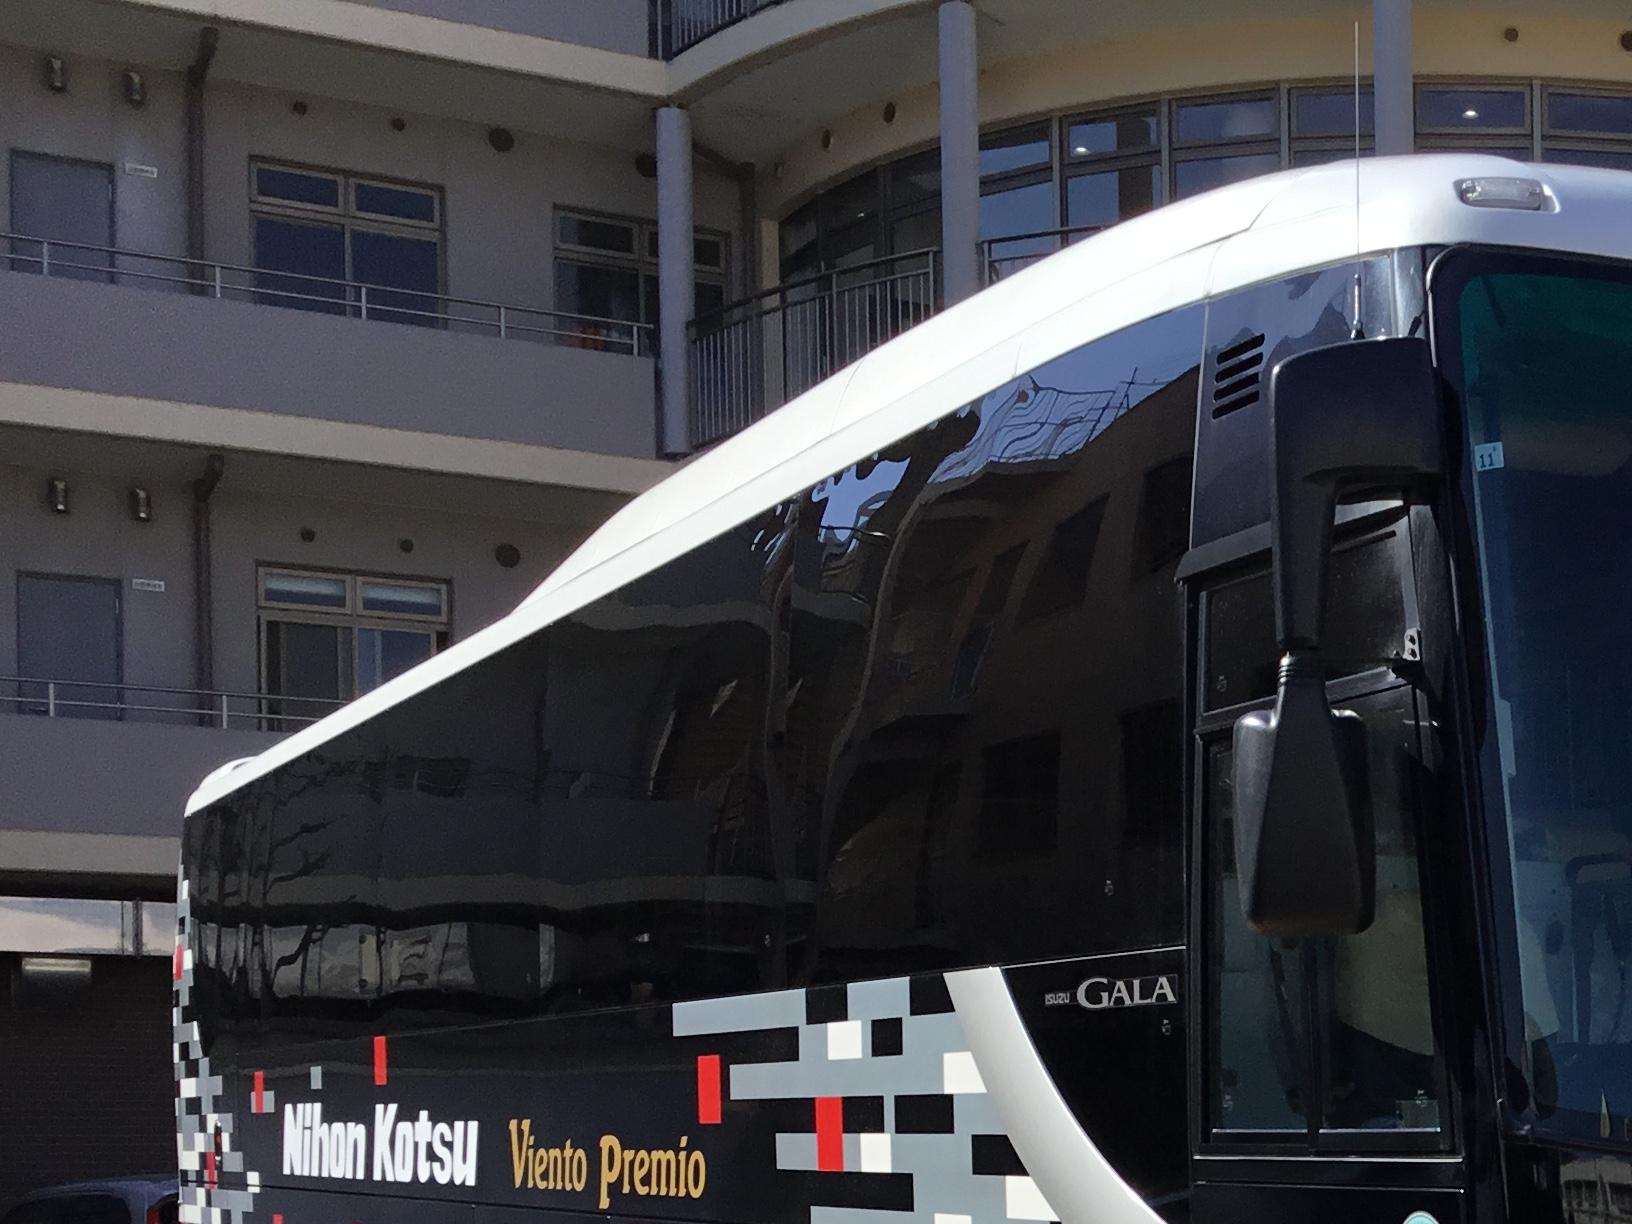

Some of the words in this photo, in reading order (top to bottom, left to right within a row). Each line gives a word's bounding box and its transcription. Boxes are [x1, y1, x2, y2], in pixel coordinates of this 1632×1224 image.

[1044, 992, 1071, 1005] ISUZU
[1076, 976, 1177, 1009] GALA
[282, 1102, 366, 1180] Nihon
[373, 1102, 479, 1187] Kotsu
[508, 1118, 588, 1192] Viento
[598, 1134, 706, 1210] Premio
